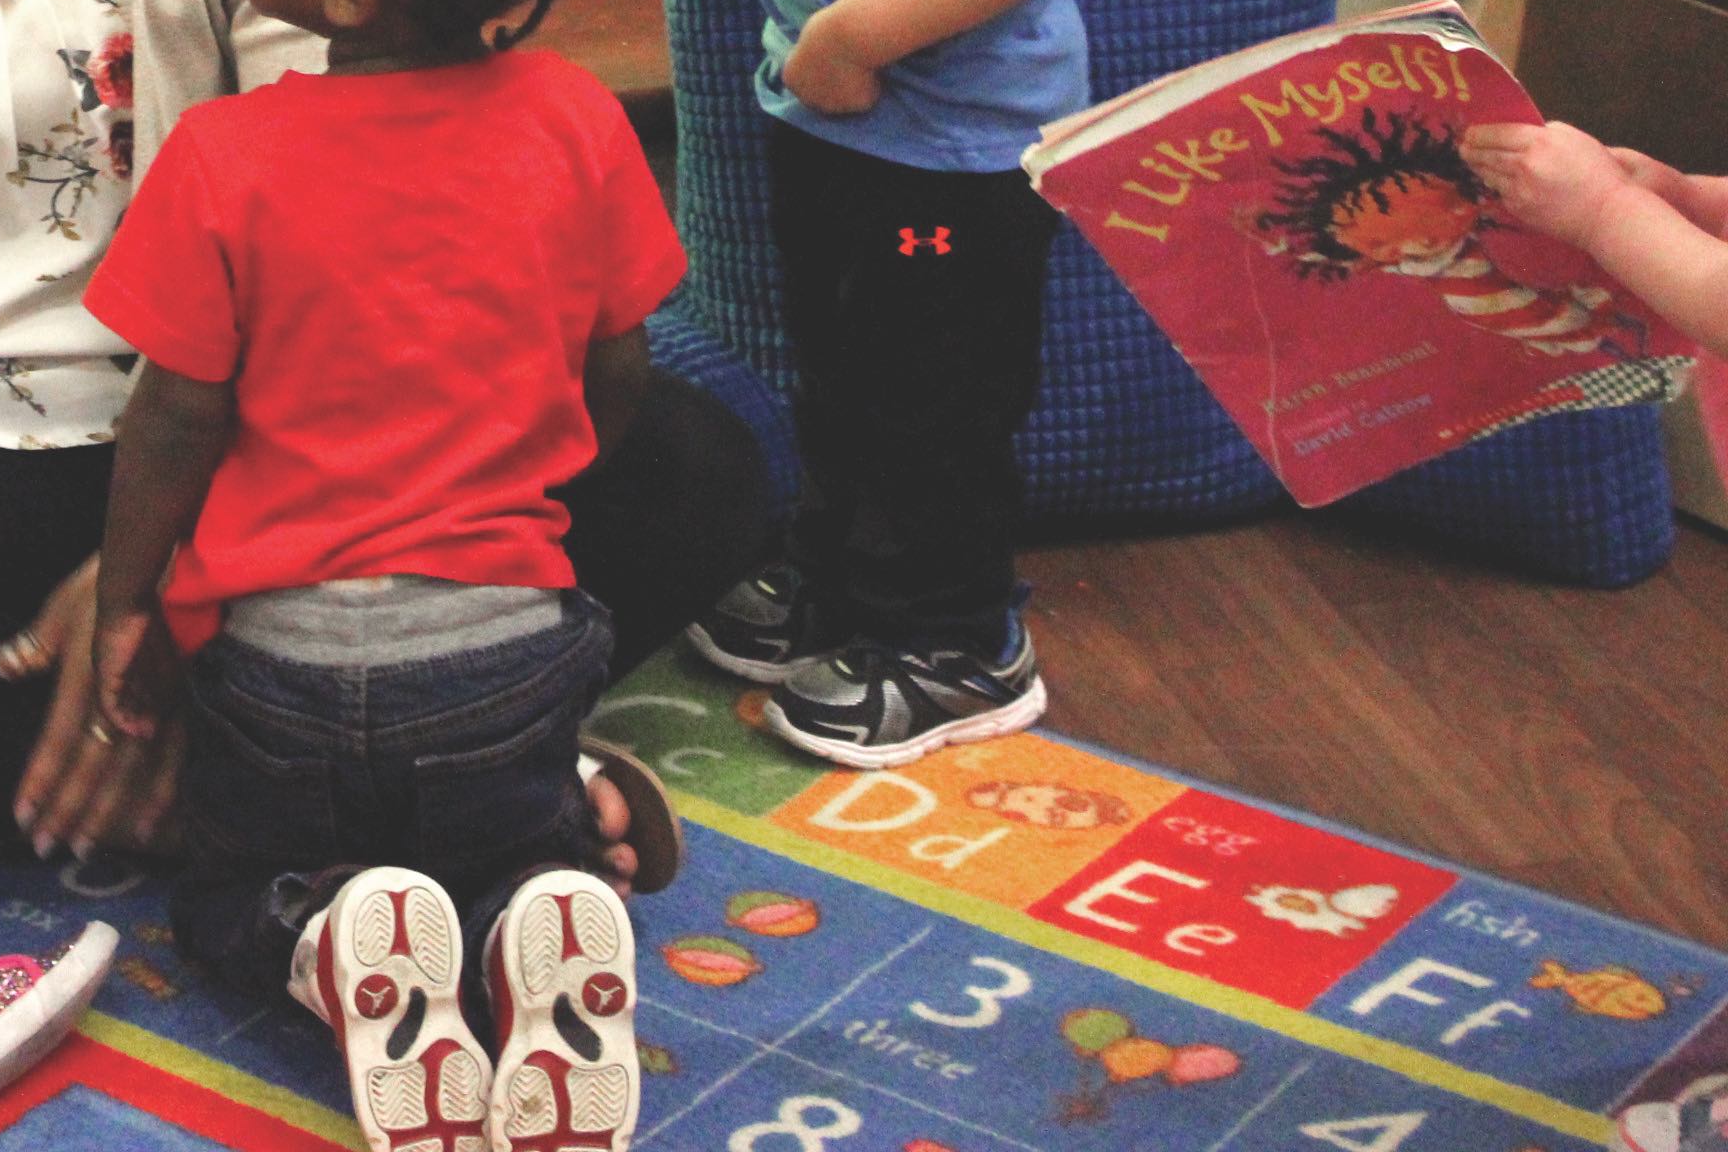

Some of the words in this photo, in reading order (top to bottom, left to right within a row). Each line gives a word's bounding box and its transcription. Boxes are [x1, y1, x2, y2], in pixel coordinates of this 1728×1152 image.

[1239, 43, 1472, 147] Myself!
[1122, 127, 1251, 206] Like
[1104, 211, 1171, 243] I
[1162, 816, 1261, 857] egg
[1442, 899, 1541, 946] fish
[908, 955, 1033, 1029] 3
[842, 1018, 976, 1080] three
